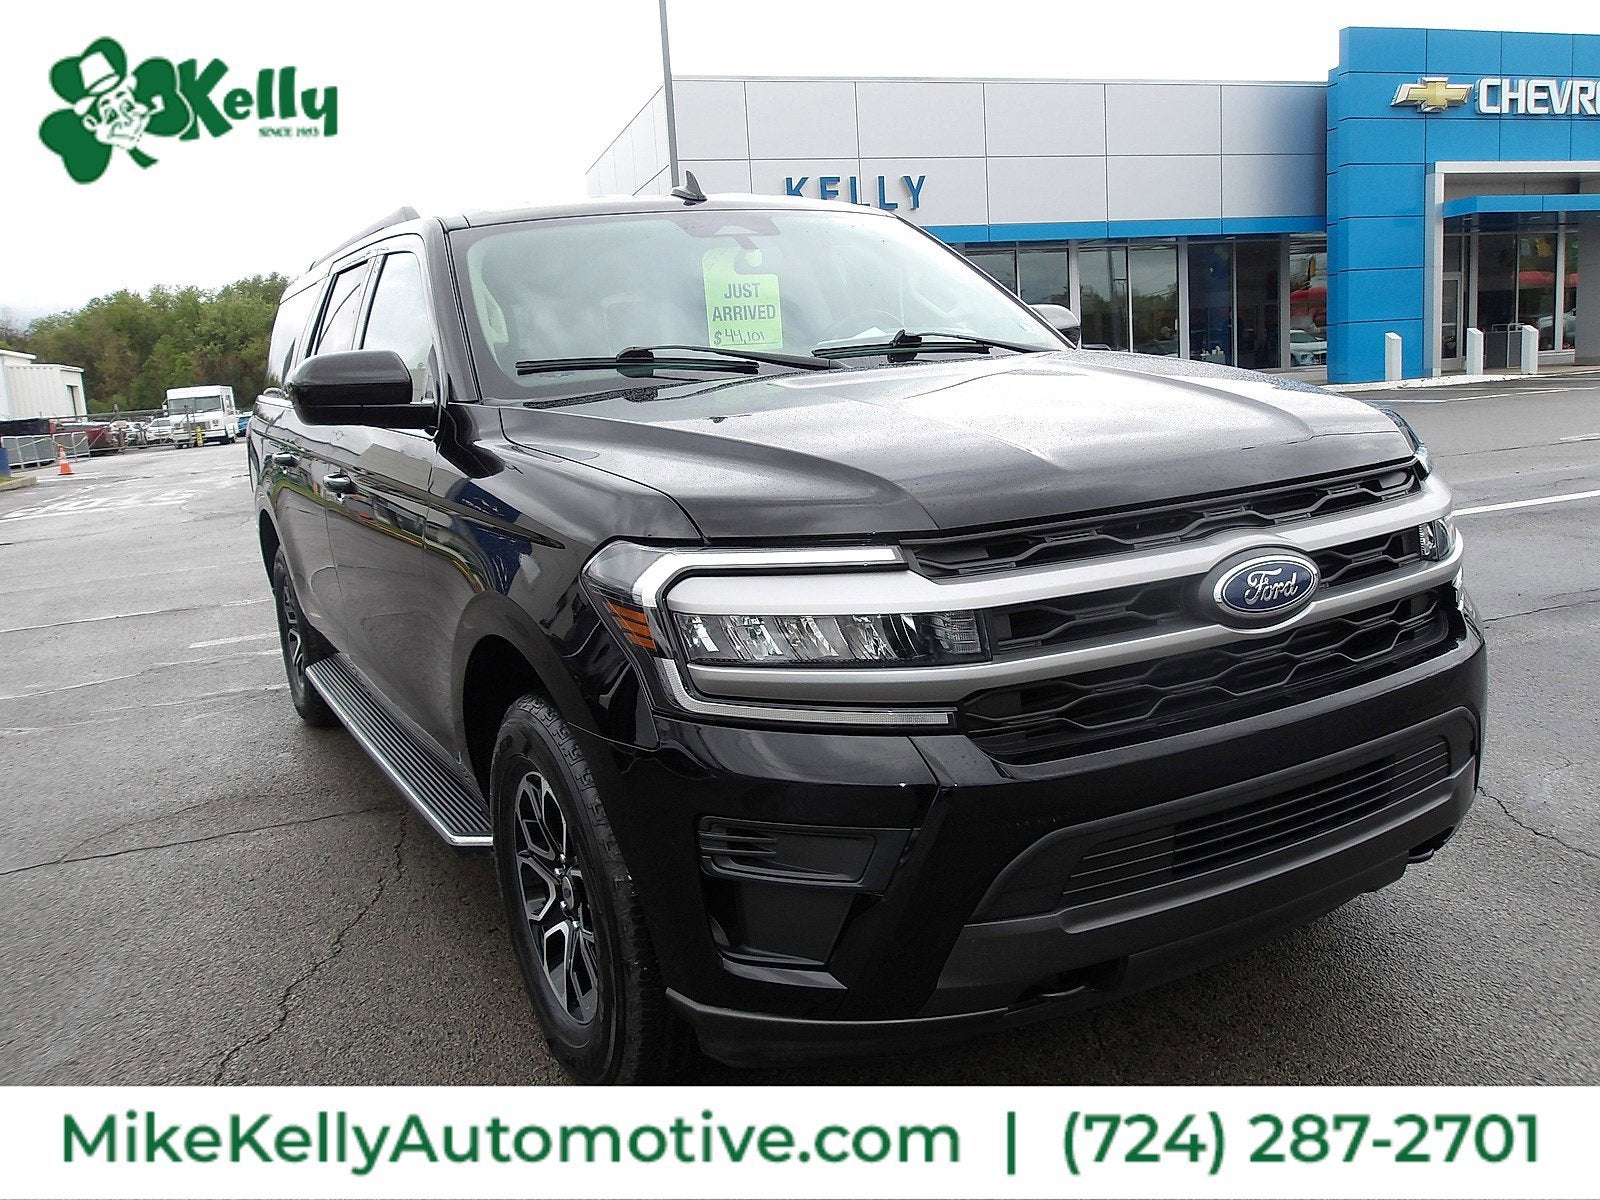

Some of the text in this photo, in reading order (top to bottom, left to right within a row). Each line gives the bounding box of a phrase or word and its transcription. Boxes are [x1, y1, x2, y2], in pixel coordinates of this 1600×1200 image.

[1475, 78, 1600, 115] CHEVR
[785, 175, 926, 210] KELLY
[724, 282, 761, 299] JUST
[712, 304, 776, 322] ARRIVED
[1244, 567, 1298, 605] Ford
